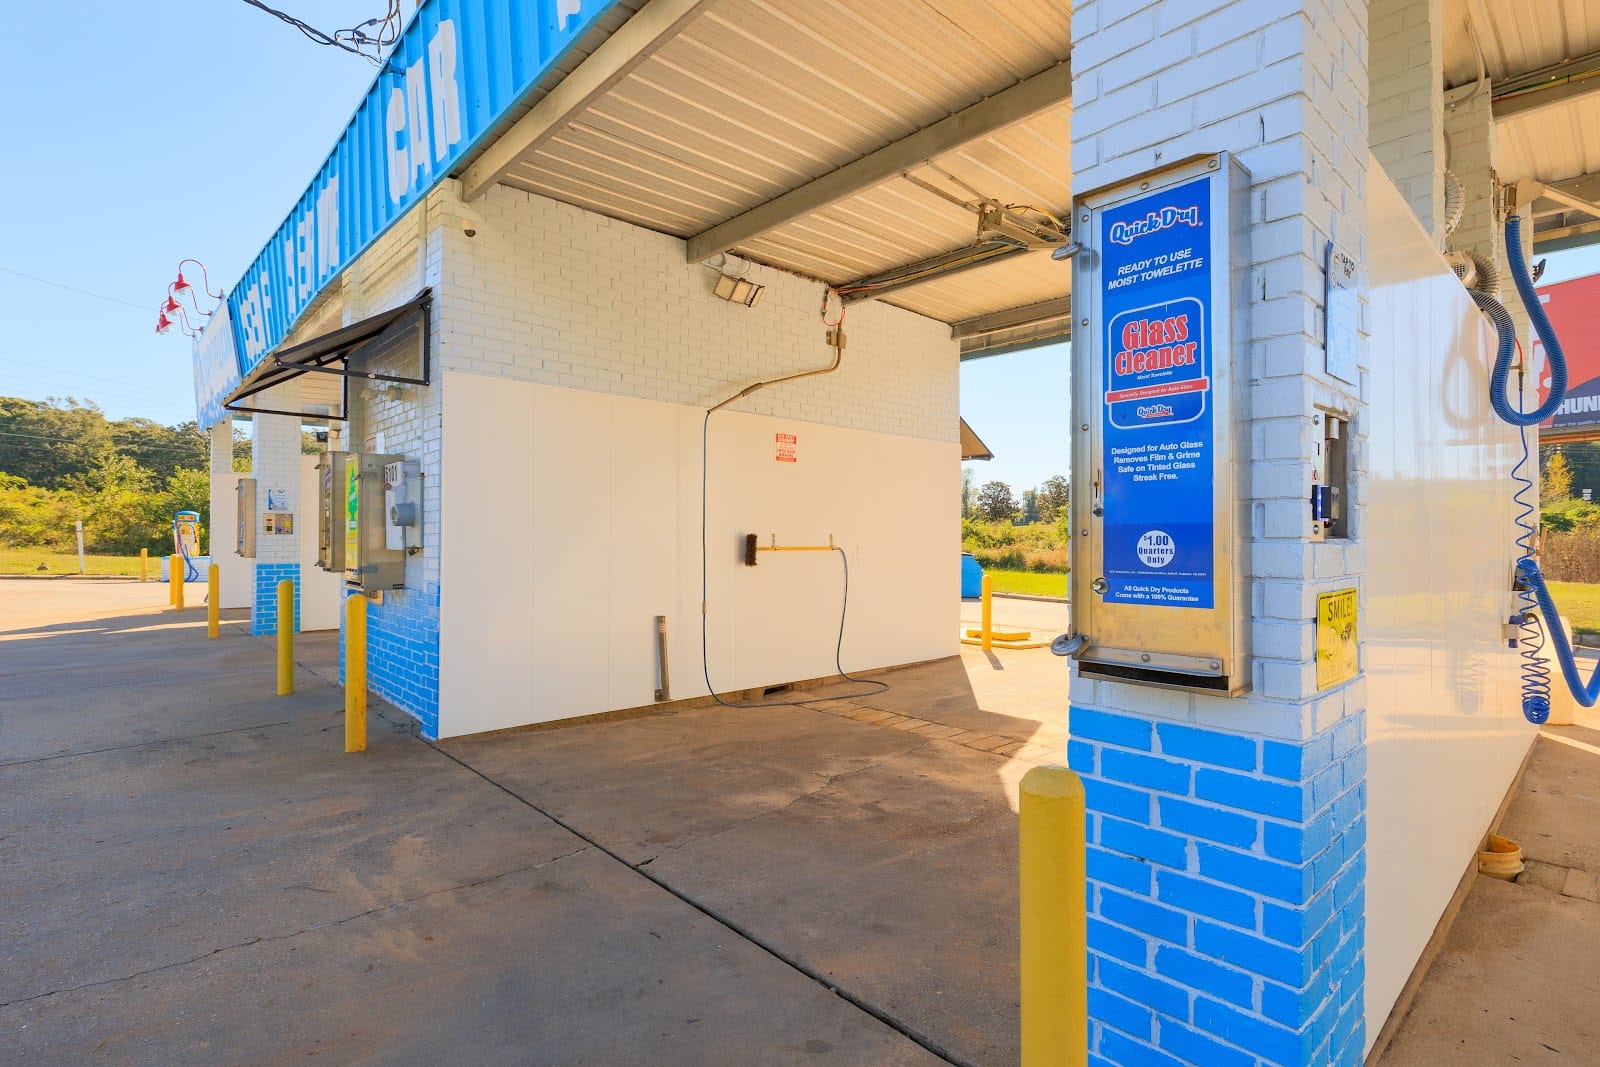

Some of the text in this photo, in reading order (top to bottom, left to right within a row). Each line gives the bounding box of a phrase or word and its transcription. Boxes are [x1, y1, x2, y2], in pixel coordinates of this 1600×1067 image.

[240, 19, 462, 360] SELF SERVE CAR
[1109, 212, 1160, 246] Quick
[1117, 248, 1192, 276] READY TO USE
[1108, 258, 1203, 291] MOIST TOWELETTE
[1122, 314, 1189, 352] Glass
[1114, 342, 1198, 377] Cleaner
[1111, 440, 1204, 456] Designed for Auto Glass
[1113, 450, 1201, 464] Removes Film & Grime
[1118, 464, 1134, 473] Safe
[1146, 462, 1172, 472] Tinted
[1173, 461, 1196, 470] Glass
[1133, 472, 1179, 482] Streak Free.
[1138, 547, 1174, 555] Quarters
[1147, 556, 1165, 565] Only
[1161, 586, 1189, 594] Products
[1327, 595, 1353, 622] SMILE!
